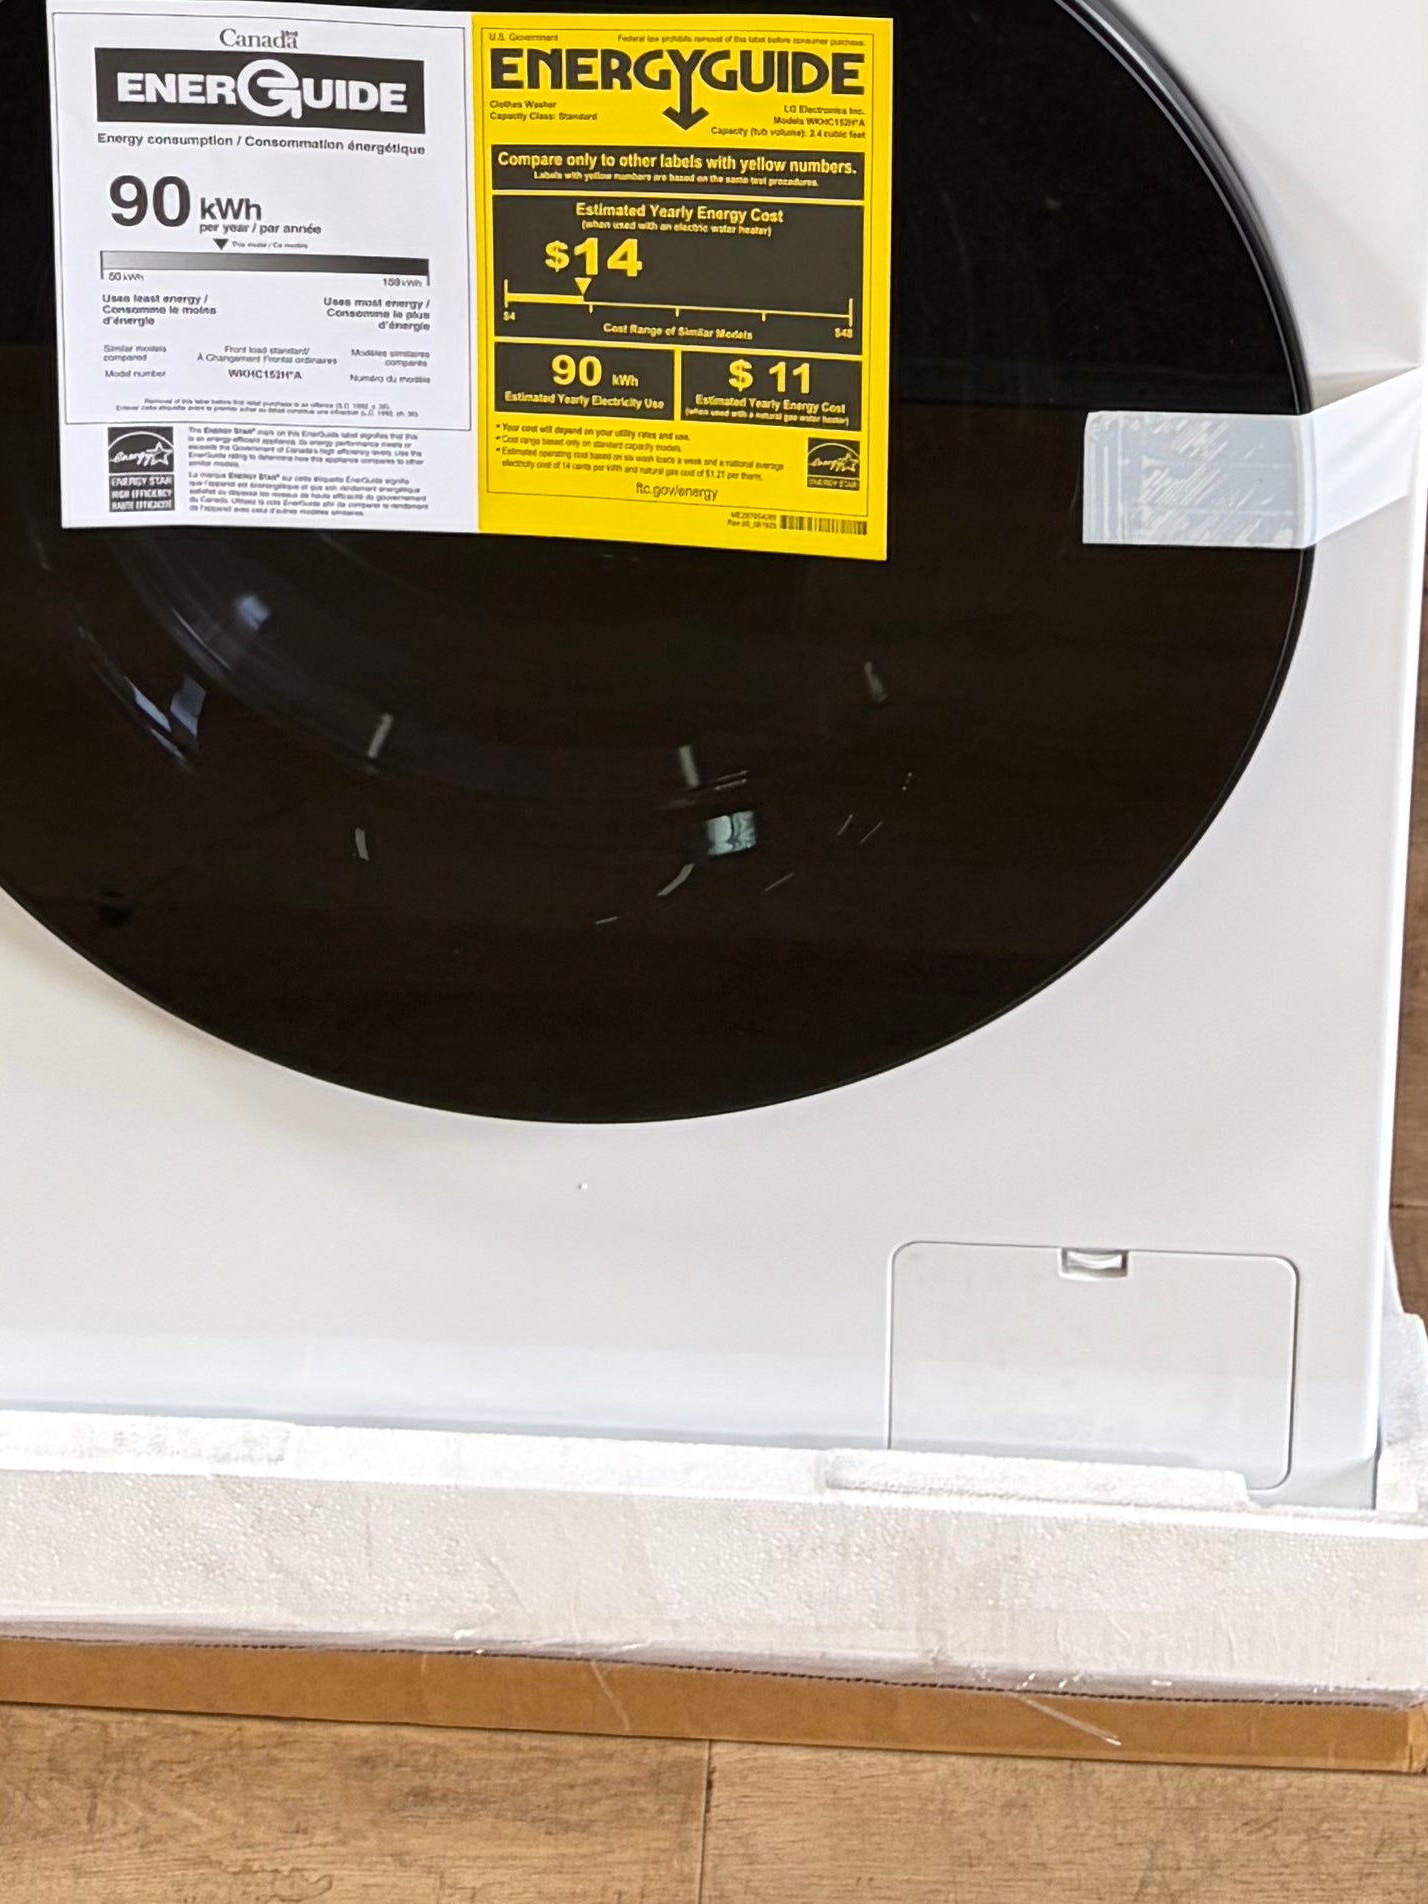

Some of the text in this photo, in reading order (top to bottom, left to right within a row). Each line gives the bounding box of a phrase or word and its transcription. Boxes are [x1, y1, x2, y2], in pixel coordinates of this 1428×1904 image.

[220, 28, 298, 49] Canada
[508, 33, 559, 42] Government
[490, 48, 864, 96] ENERGYGUIDE
[117, 59, 408, 119] ENERGUIDE
[489, 100, 557, 109] Clothes Washer
[784, 105, 797, 113] LG
[799, 105, 847, 115] Electronics
[489, 112, 527, 121] Capacity
[558, 112, 597, 120] Standard
[711, 127, 748, 137] Capacity
[848, 130, 866, 139] feet
[97, 133, 143, 148] Energy
[147, 133, 233, 148] consumption
[245, 135, 344, 150] Consommation
[347, 140, 425, 156] énergétique
[498, 151, 857, 175] Compare only to other labels with yellow numbers.
[534, 171, 563, 180] Labels
[564, 171, 583, 180] with
[584, 172, 612, 182] yellow
[614, 172, 652, 181] numbers
[653, 174, 666, 182] are
[669, 173, 695, 182] based
[710, 174, 724, 183] the
[725, 176, 749, 185] same
[110, 175, 262, 227] 90 kWh
[575, 202, 784, 223] Estimated Yearly Energy Cost
[199, 223, 219, 235] per
[222, 223, 249, 235] year
[259, 224, 280, 236] par
[282, 223, 322, 234] année
[581, 219, 611, 230] (when
[612, 220, 636, 230] used
[638, 221, 658, 231] with
[659, 223, 672, 231] an
[673, 223, 709, 233] electric
[710, 224, 736, 234] water
[544, 237, 643, 277] $14
[102, 294, 130, 303] Uses
[133, 294, 160, 303] least
[163, 295, 201, 305] energy
[323, 297, 351, 306] Uses
[354, 298, 382, 307] most
[385, 300, 423, 310] energy
[102, 305, 216, 314] Consomme le moins
[326, 308, 430, 320] Consomme le plus
[603, 323, 753, 340] Cost Range of Similar Models
[551, 354, 639, 387] 90 kWh
[504, 391, 664, 410] Estimated Yearly Electricity Use
[695, 394, 846, 414] Estimated Yearly Energy Cost
[111, 477, 146, 487] ENERGY
[636, 482, 718, 501] ftc.gov/energy
